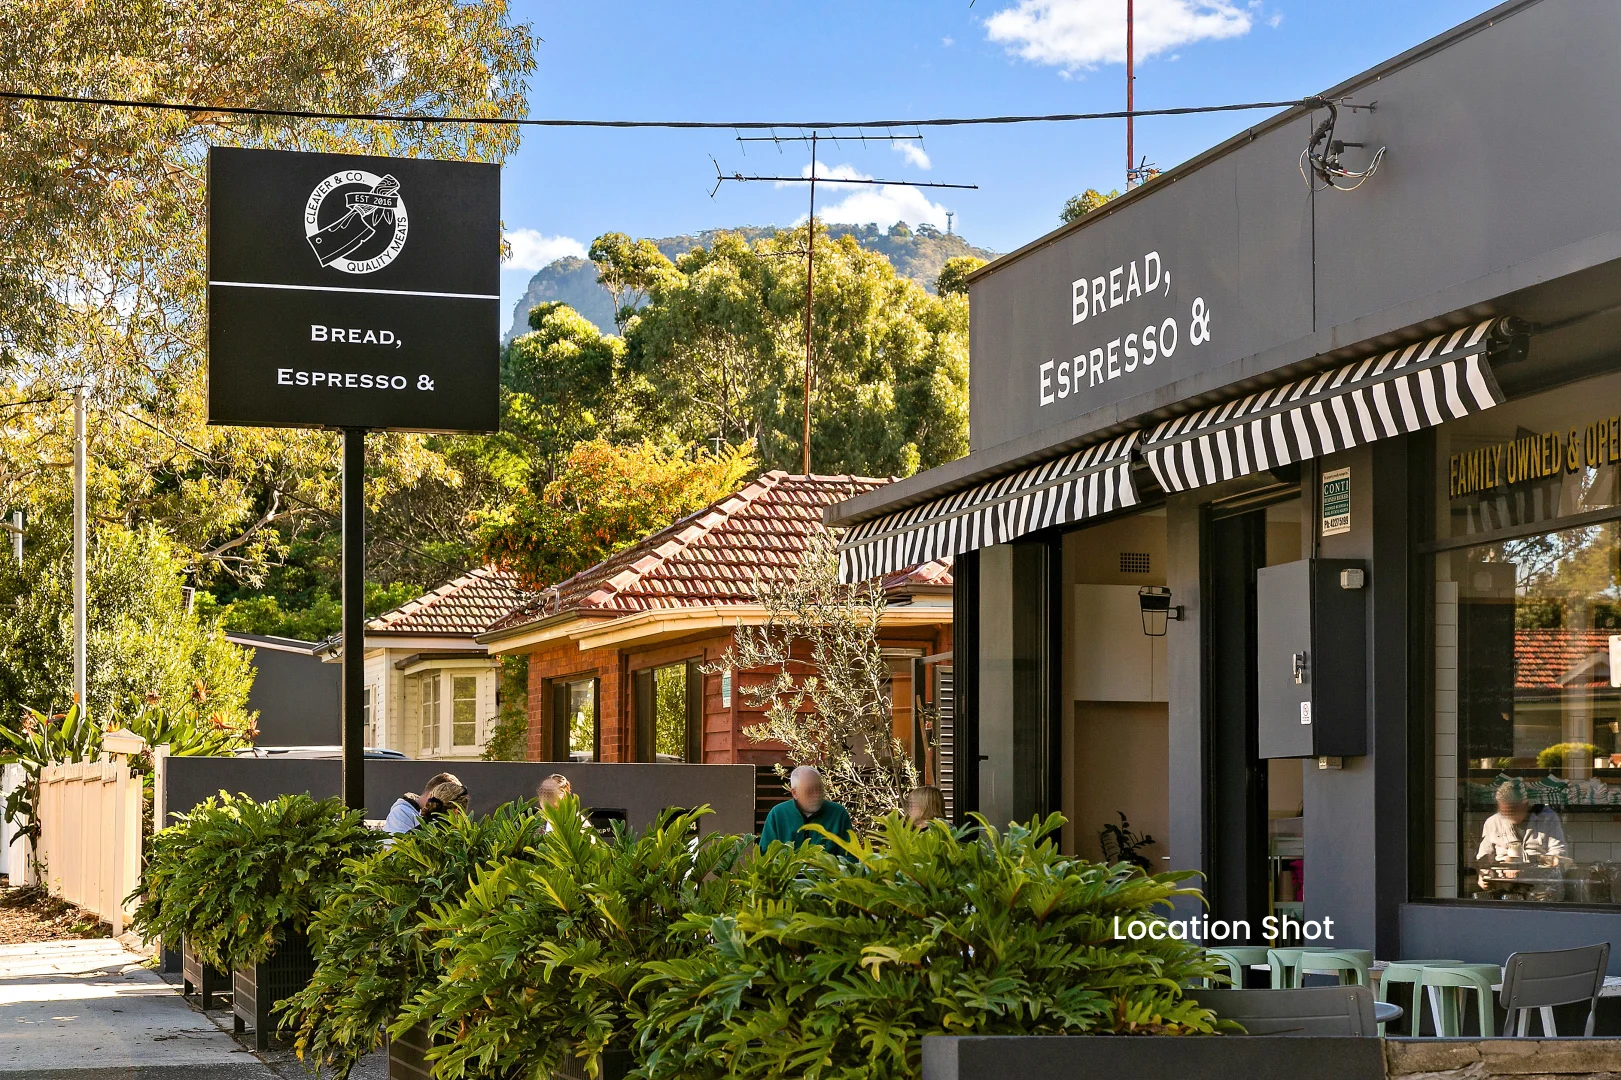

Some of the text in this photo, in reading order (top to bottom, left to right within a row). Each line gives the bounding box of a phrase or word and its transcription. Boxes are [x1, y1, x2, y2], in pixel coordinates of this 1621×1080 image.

[307, 172, 365, 225] CLEAVER & CO.
[355, 194, 392, 206] EST 2016
[347, 216, 407, 272] QUALITY MEATS
[1039, 296, 1211, 407] ESPRESSO &
[277, 368, 435, 391] ESPRESSO &
[1449, 414, 1621, 500] FAMILY OWNED & OPE
[1324, 480, 1349, 495] CONTI
